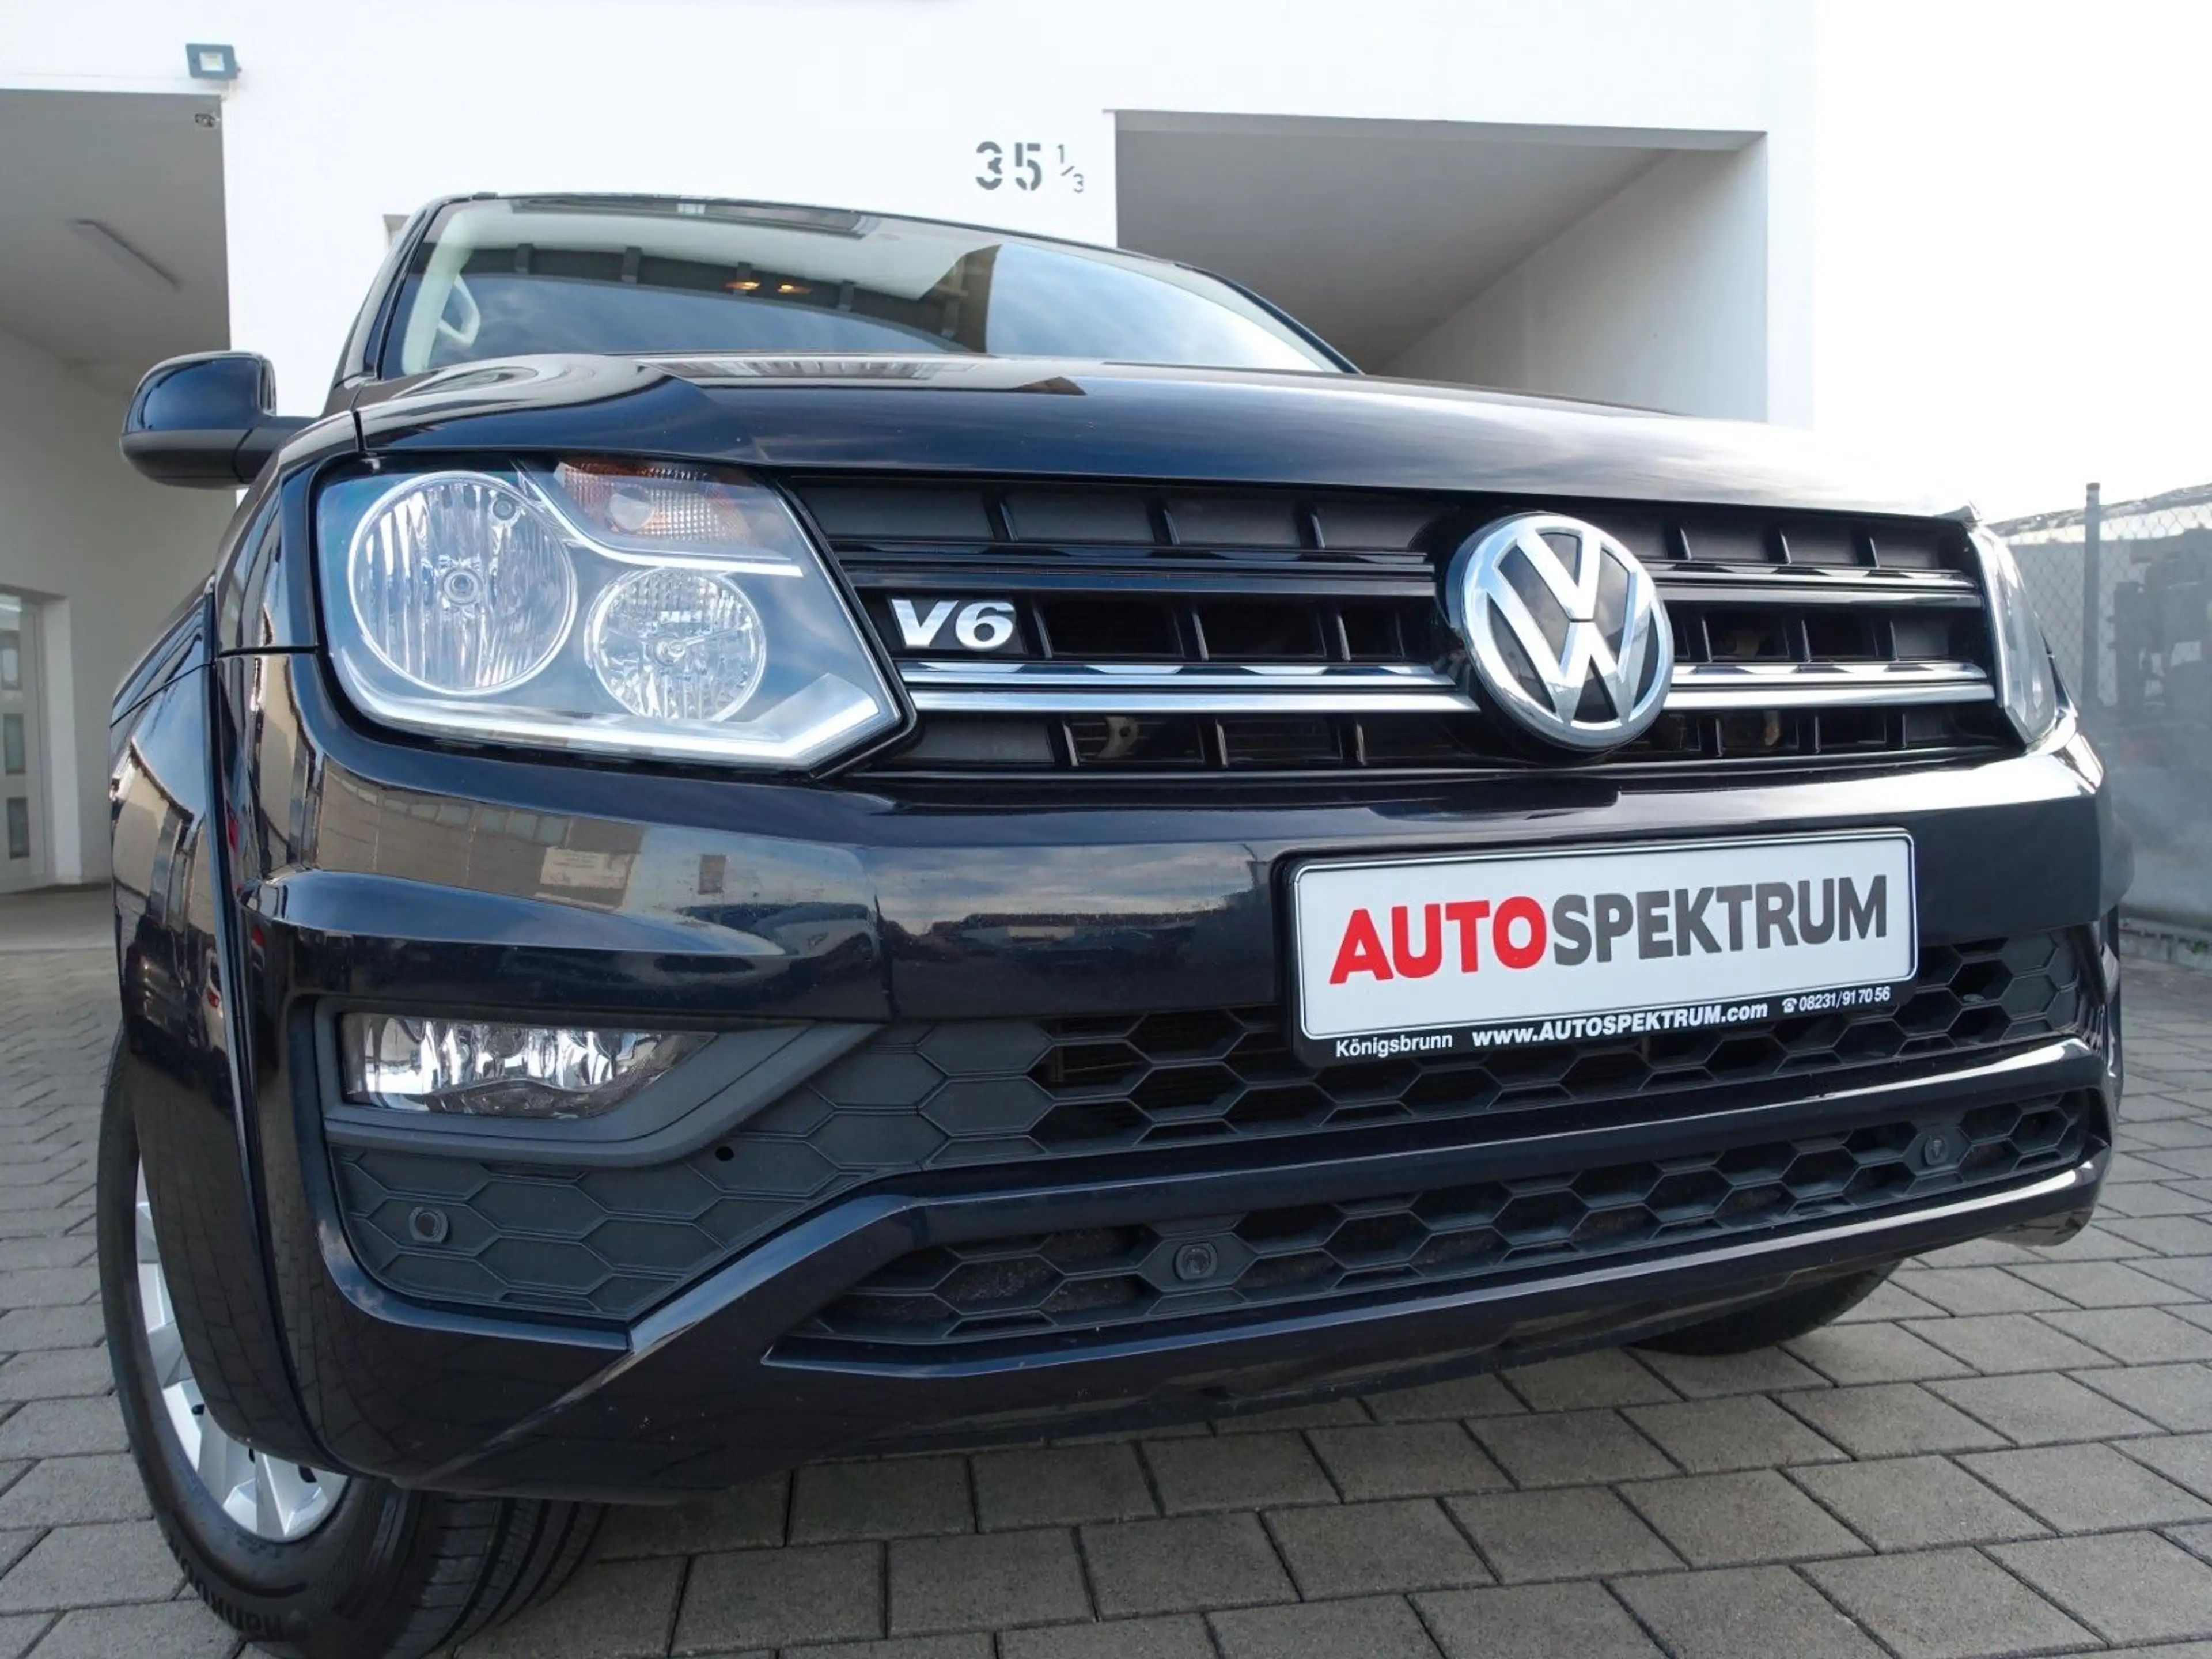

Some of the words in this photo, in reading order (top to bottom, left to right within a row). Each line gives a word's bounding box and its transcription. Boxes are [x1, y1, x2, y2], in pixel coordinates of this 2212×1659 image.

[976, 141, 1042, 190] 35
[891, 599, 1015, 650] V6
[1329, 874, 1888, 985] AUTOSPEKTRUM
[1336, 1035, 1452, 1058] Königsbrunn
[1472, 1001, 1768, 1047] www.AUTOSPEKTRUM.com
